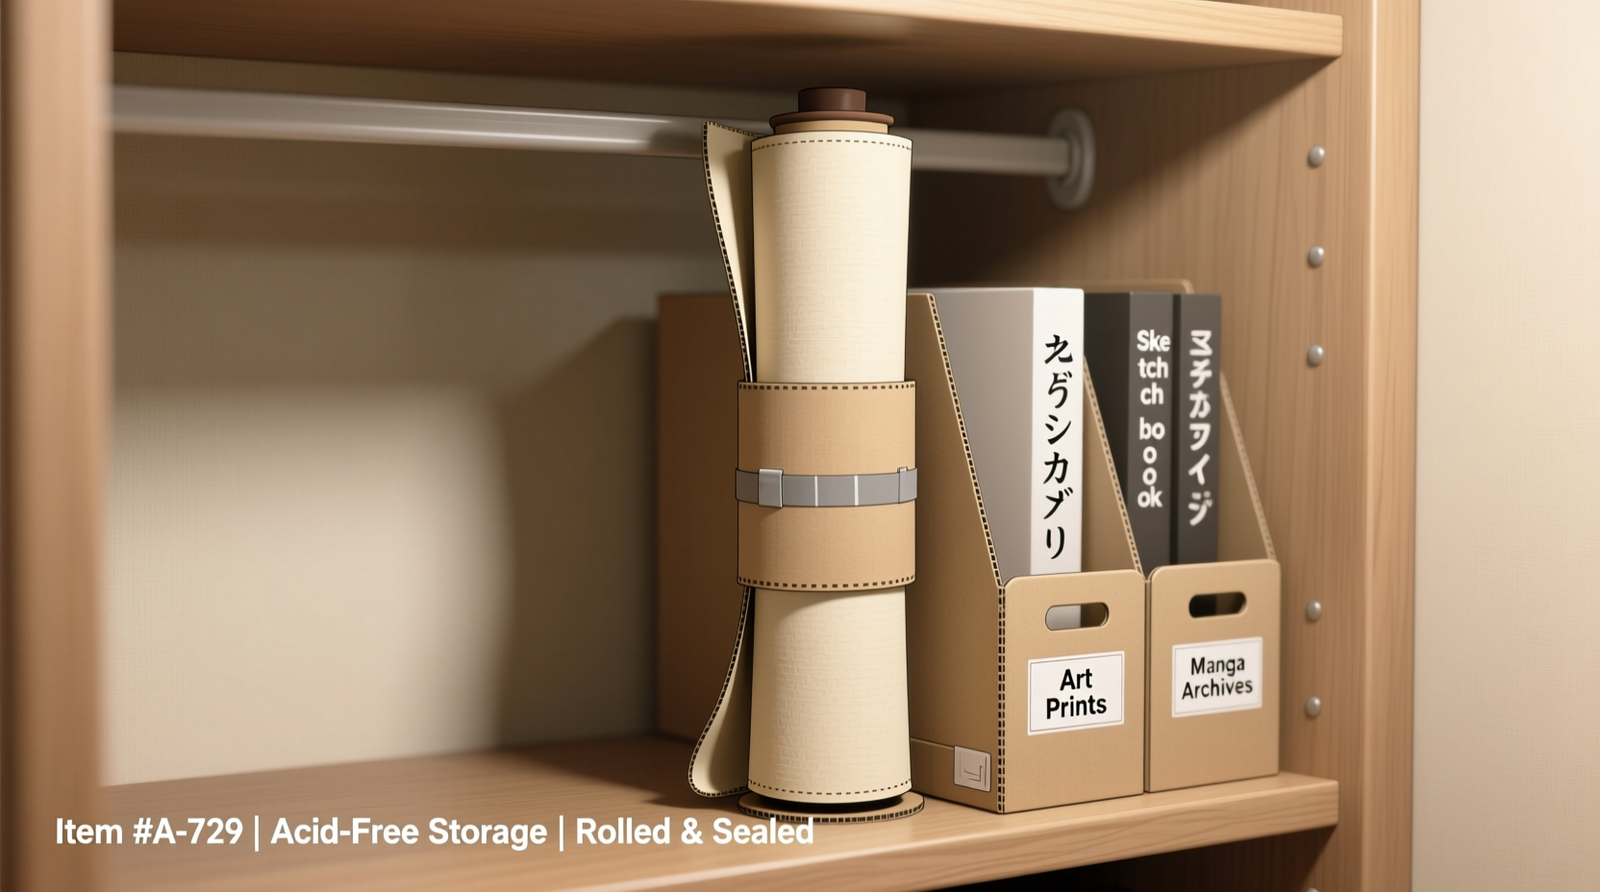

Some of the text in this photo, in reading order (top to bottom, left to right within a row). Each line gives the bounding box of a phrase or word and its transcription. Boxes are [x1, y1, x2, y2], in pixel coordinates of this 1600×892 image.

[1190, 656, 1246, 677] Manga
[1059, 668, 1094, 692] Art
[1181, 678, 1254, 701] Archives
[1046, 694, 1108, 720] Prints
